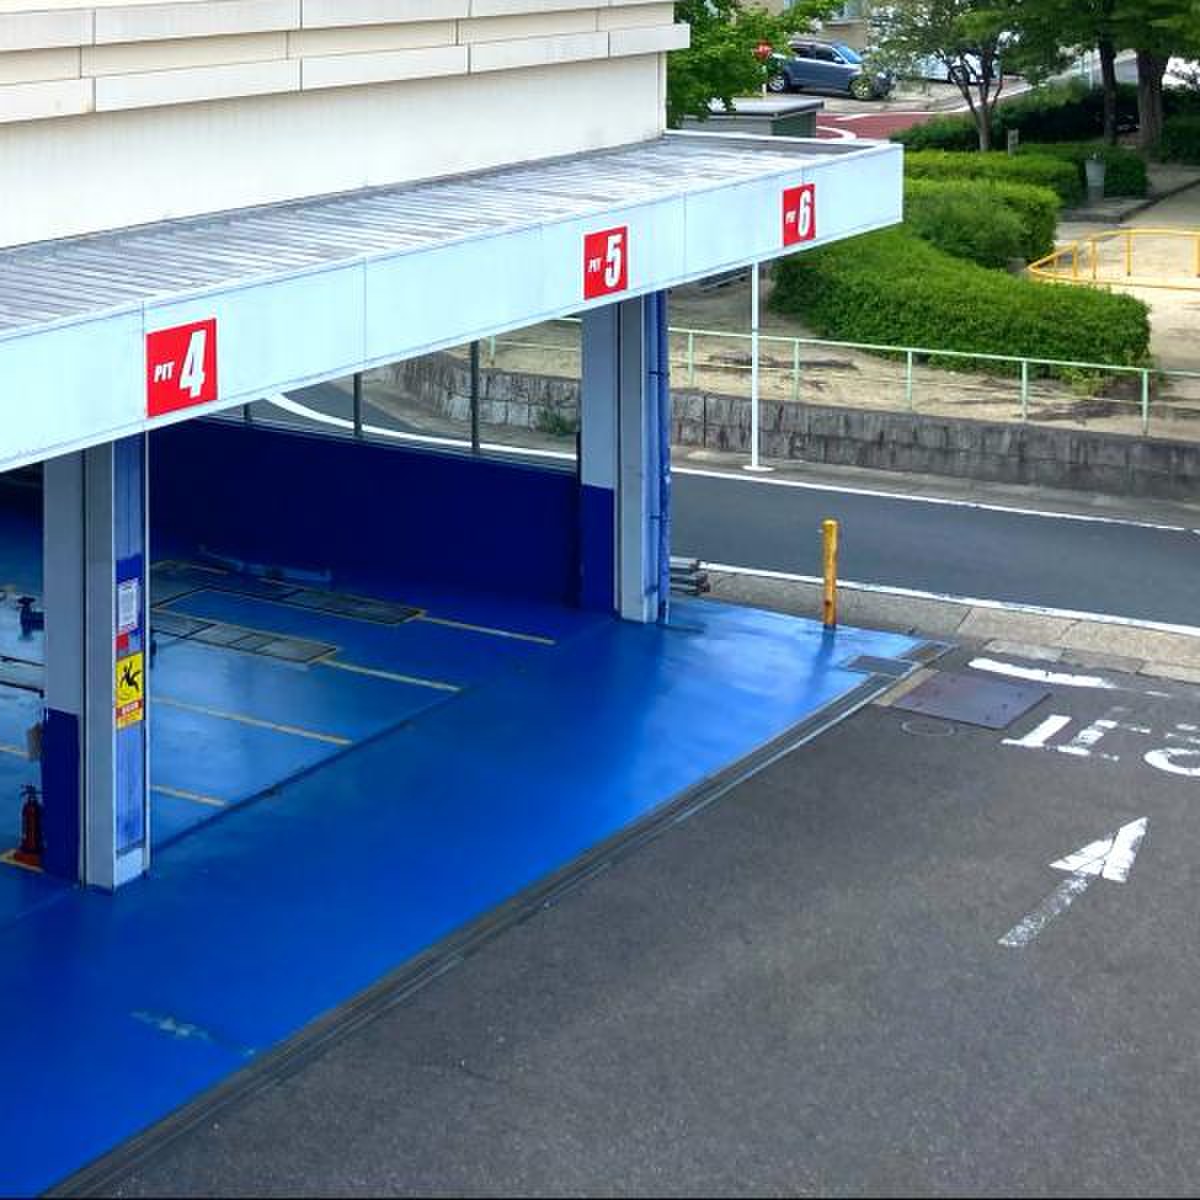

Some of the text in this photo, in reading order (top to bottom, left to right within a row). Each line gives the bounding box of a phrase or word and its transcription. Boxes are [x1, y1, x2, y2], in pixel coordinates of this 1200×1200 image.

[798, 190, 811, 237] 6
[605, 233, 622, 288] 5
[154, 330, 207, 398] PIT 4
